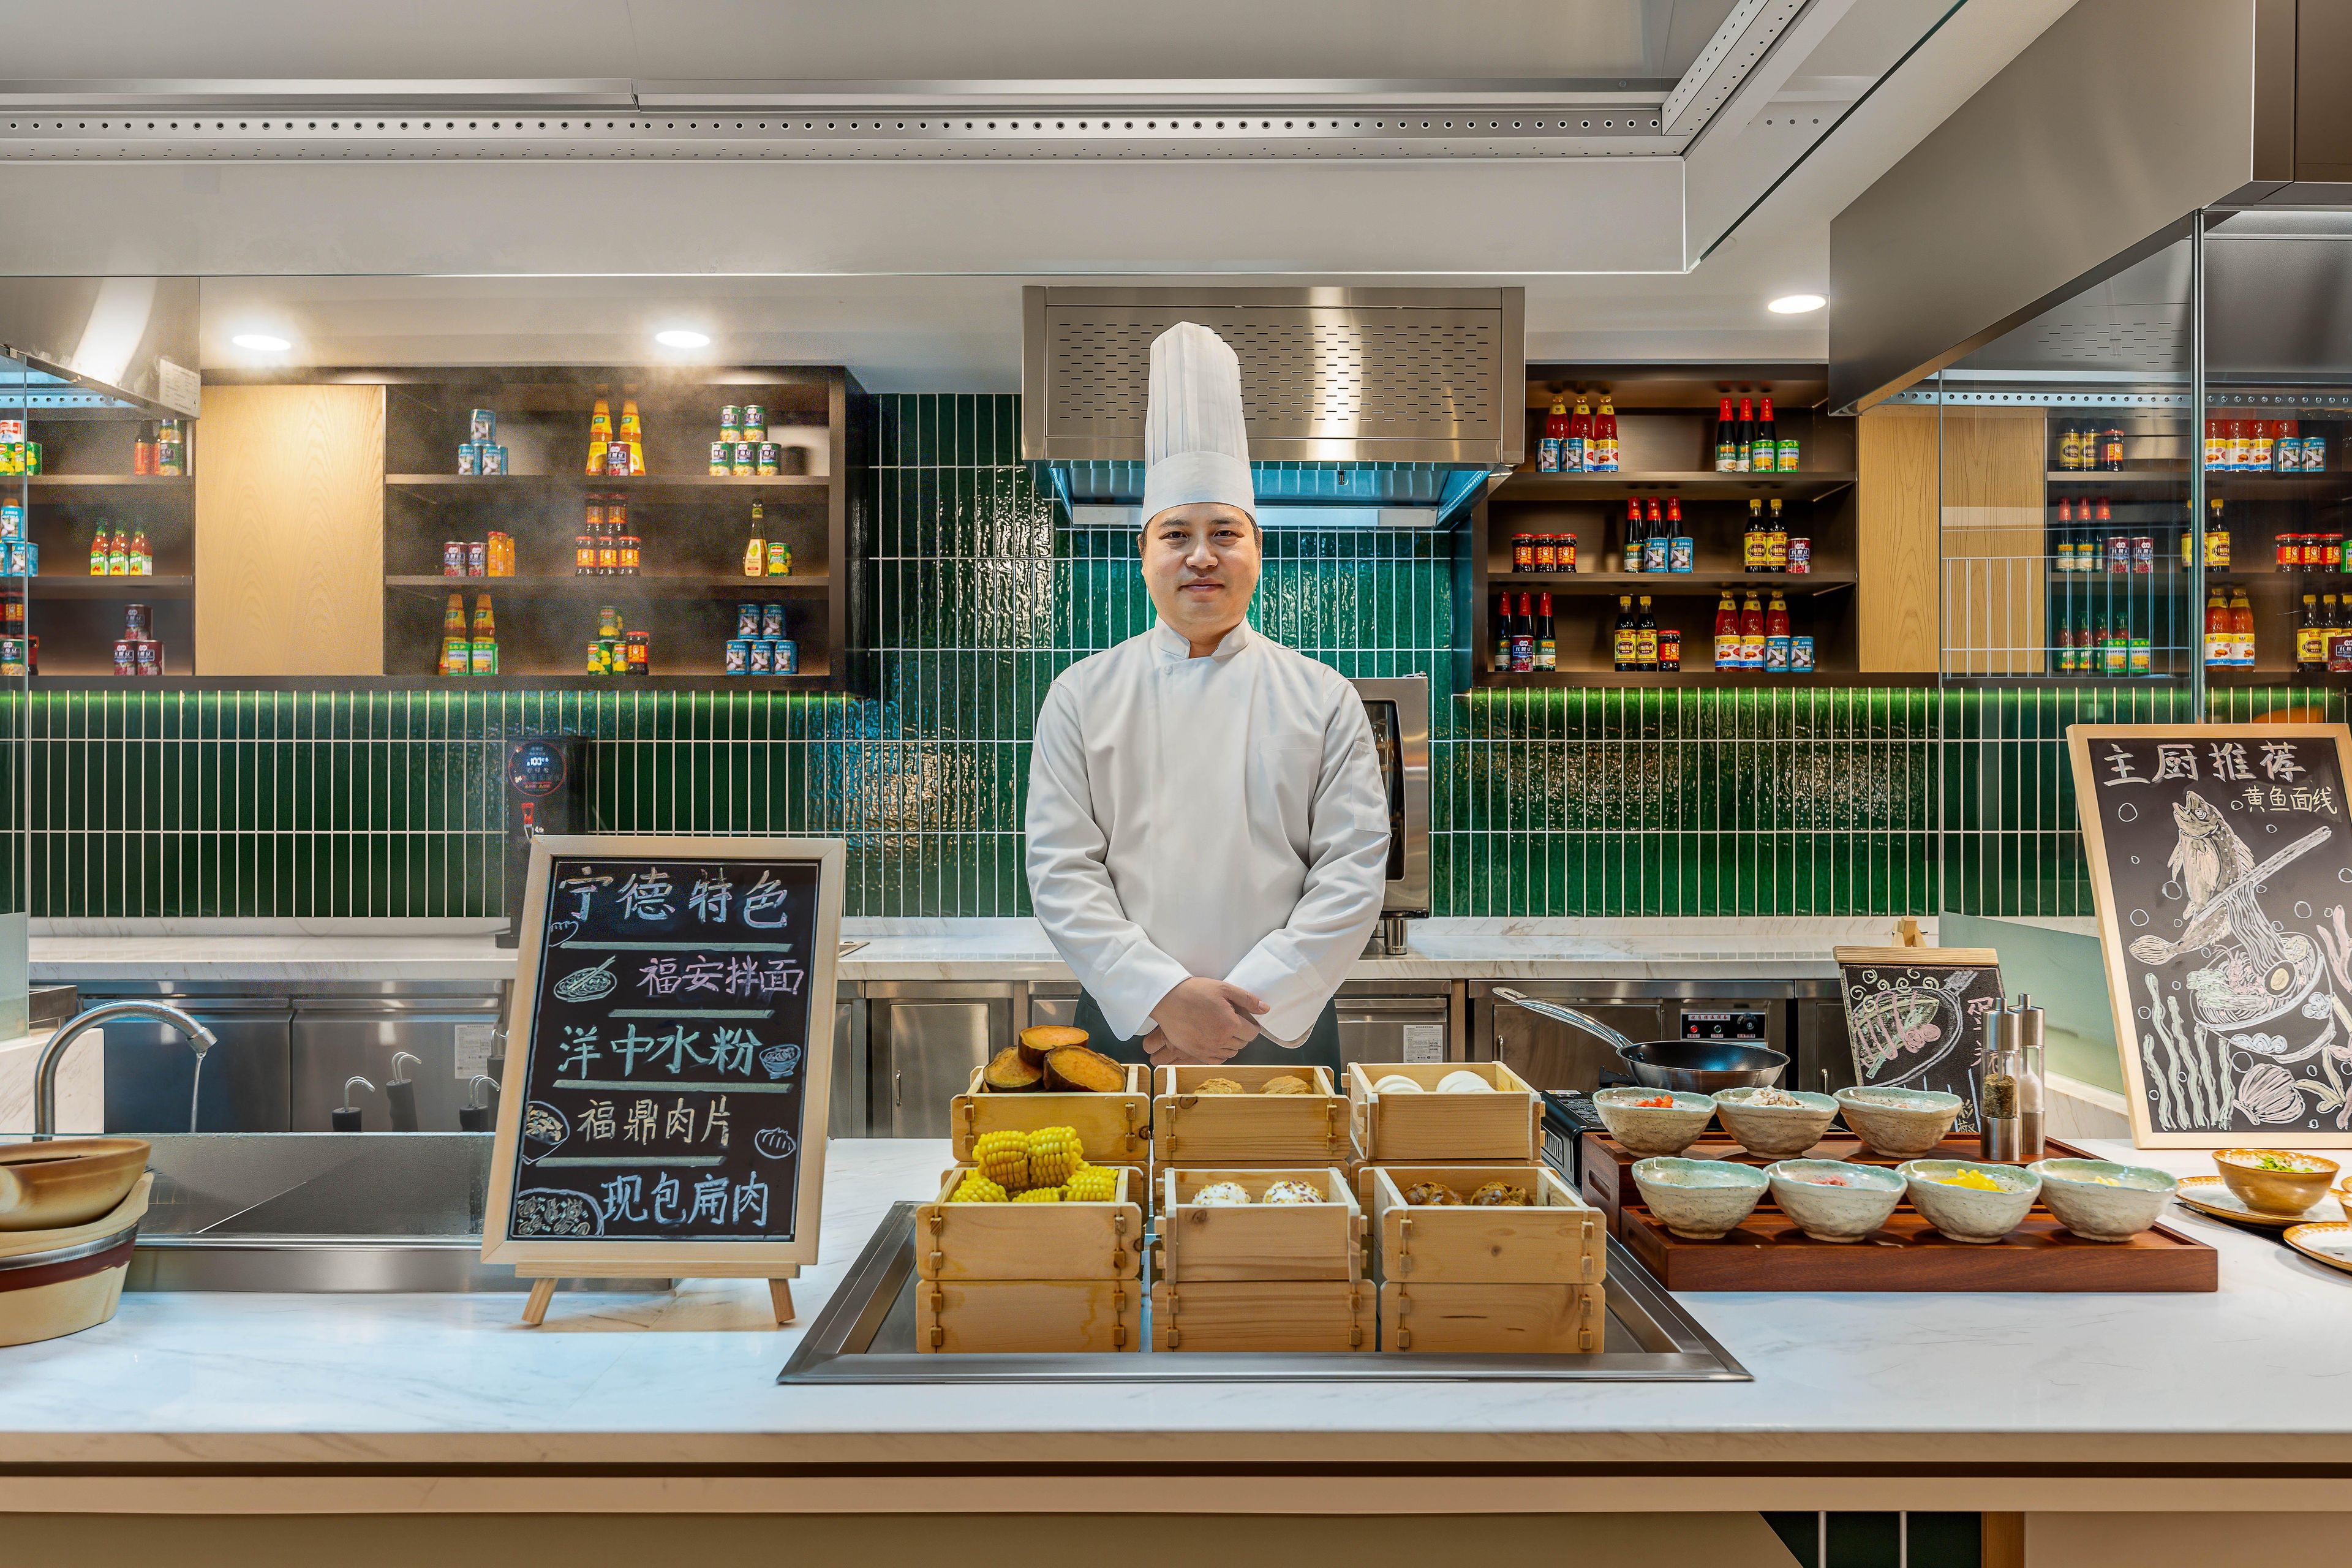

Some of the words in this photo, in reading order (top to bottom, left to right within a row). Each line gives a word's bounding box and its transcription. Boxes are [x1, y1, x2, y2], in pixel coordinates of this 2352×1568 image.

[2103, 740, 2306, 786] 主厨推荐
[2242, 785, 2338, 814] 黄鱼面线
[559, 865, 788, 929] 宁德特色
[636, 956, 804, 997] 福安拌面
[558, 1023, 763, 1079] 洋中水粉
[576, 1095, 731, 1147] 福鼎肉片
[600, 1170, 769, 1227] 现包扁肉
